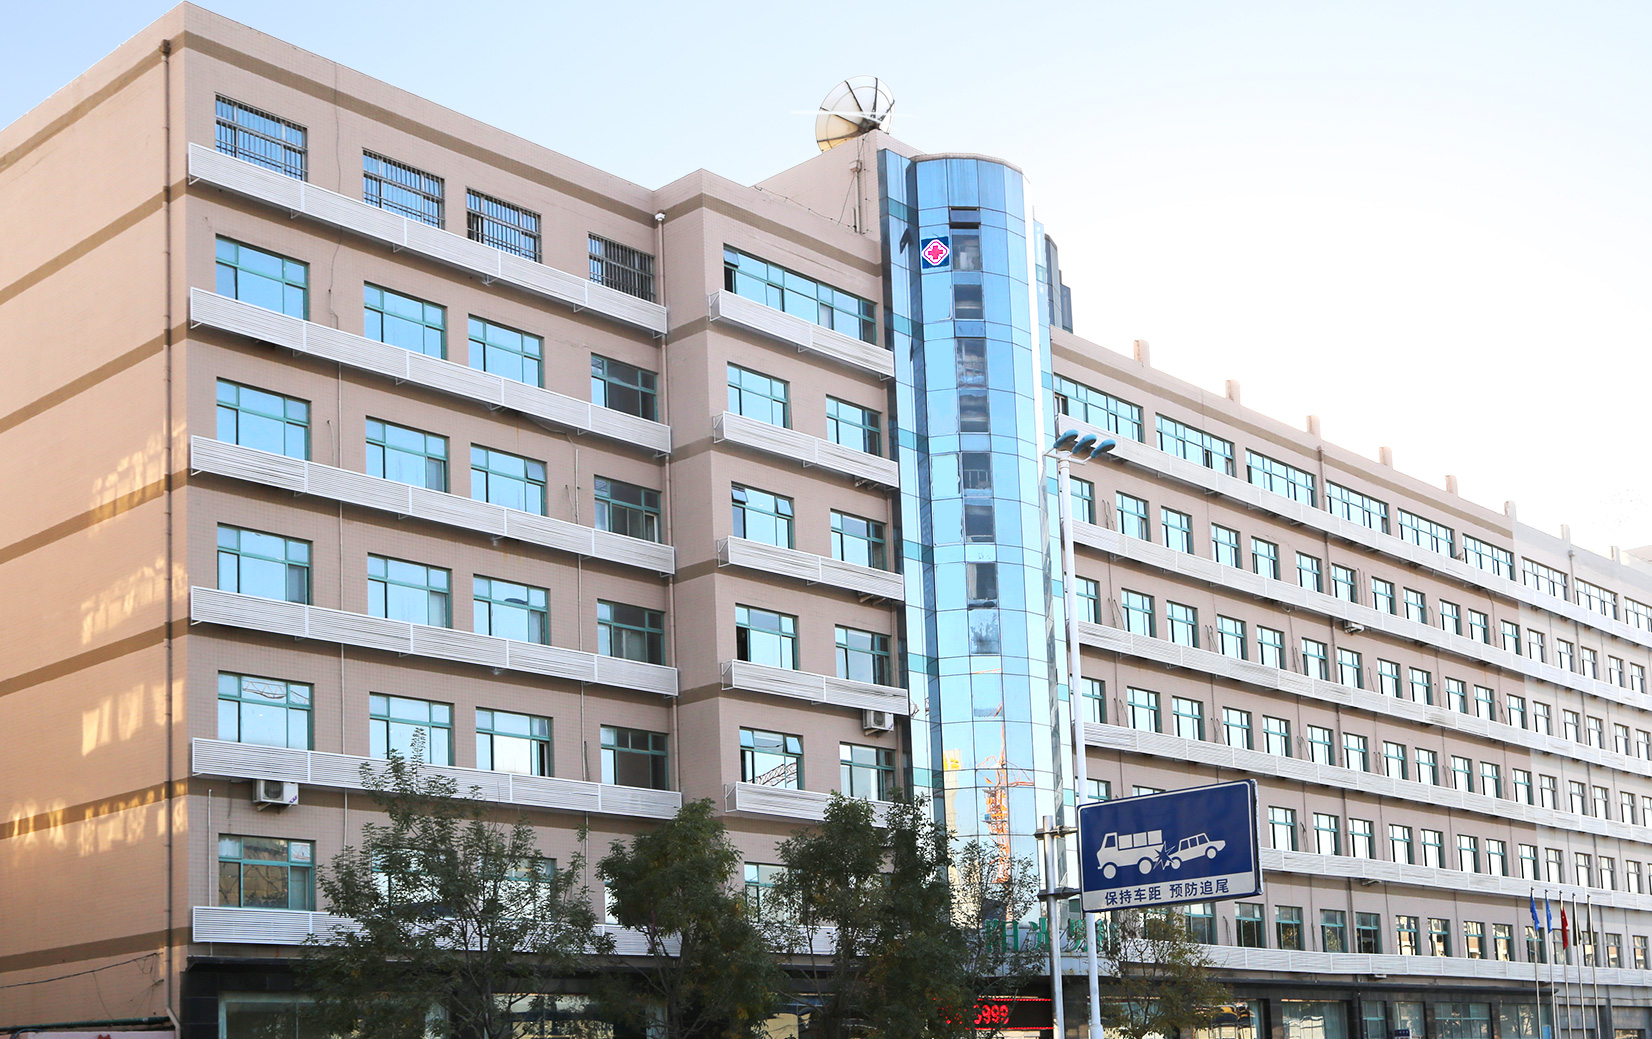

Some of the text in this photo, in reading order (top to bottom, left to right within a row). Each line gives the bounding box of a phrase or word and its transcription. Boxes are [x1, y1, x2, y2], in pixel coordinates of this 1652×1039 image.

[1105, 878, 1229, 906] 保持车距 预防追尾
